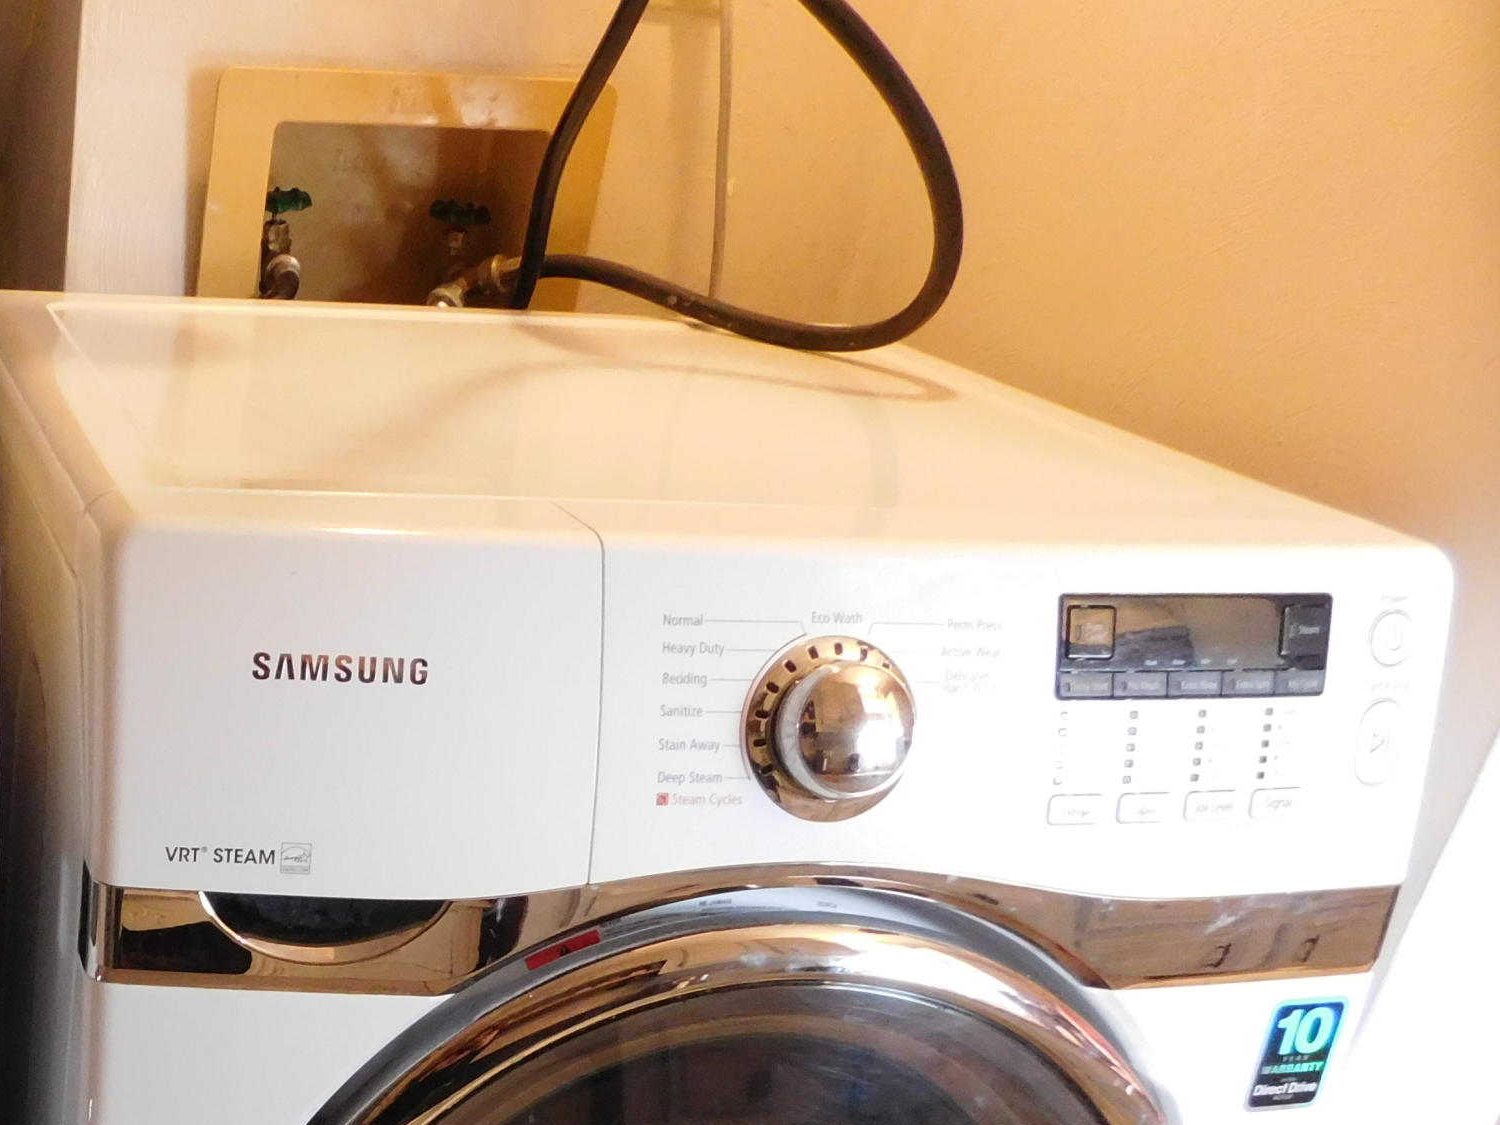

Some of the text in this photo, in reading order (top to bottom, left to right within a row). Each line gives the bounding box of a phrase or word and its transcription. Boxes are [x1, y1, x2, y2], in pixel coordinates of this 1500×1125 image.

[663, 615, 703, 627] Normal
[811, 611, 862, 624] Eco Wash
[947, 619, 976, 630] Perm
[662, 643, 724, 657] Heavy Duty
[252, 651, 428, 685] SAMSUNG
[662, 673, 707, 687] Bedding
[660, 705, 703, 717] Sanitize
[659, 739, 720, 754] Stain Away
[657, 771, 723, 786] Deep Steam
[672, 793, 742, 808] Steam Cycles
[213, 848, 275, 865] STEAM
[1278, 1007, 1335, 1055] 10
[1253, 1082, 1317, 1096] Direct Drive
